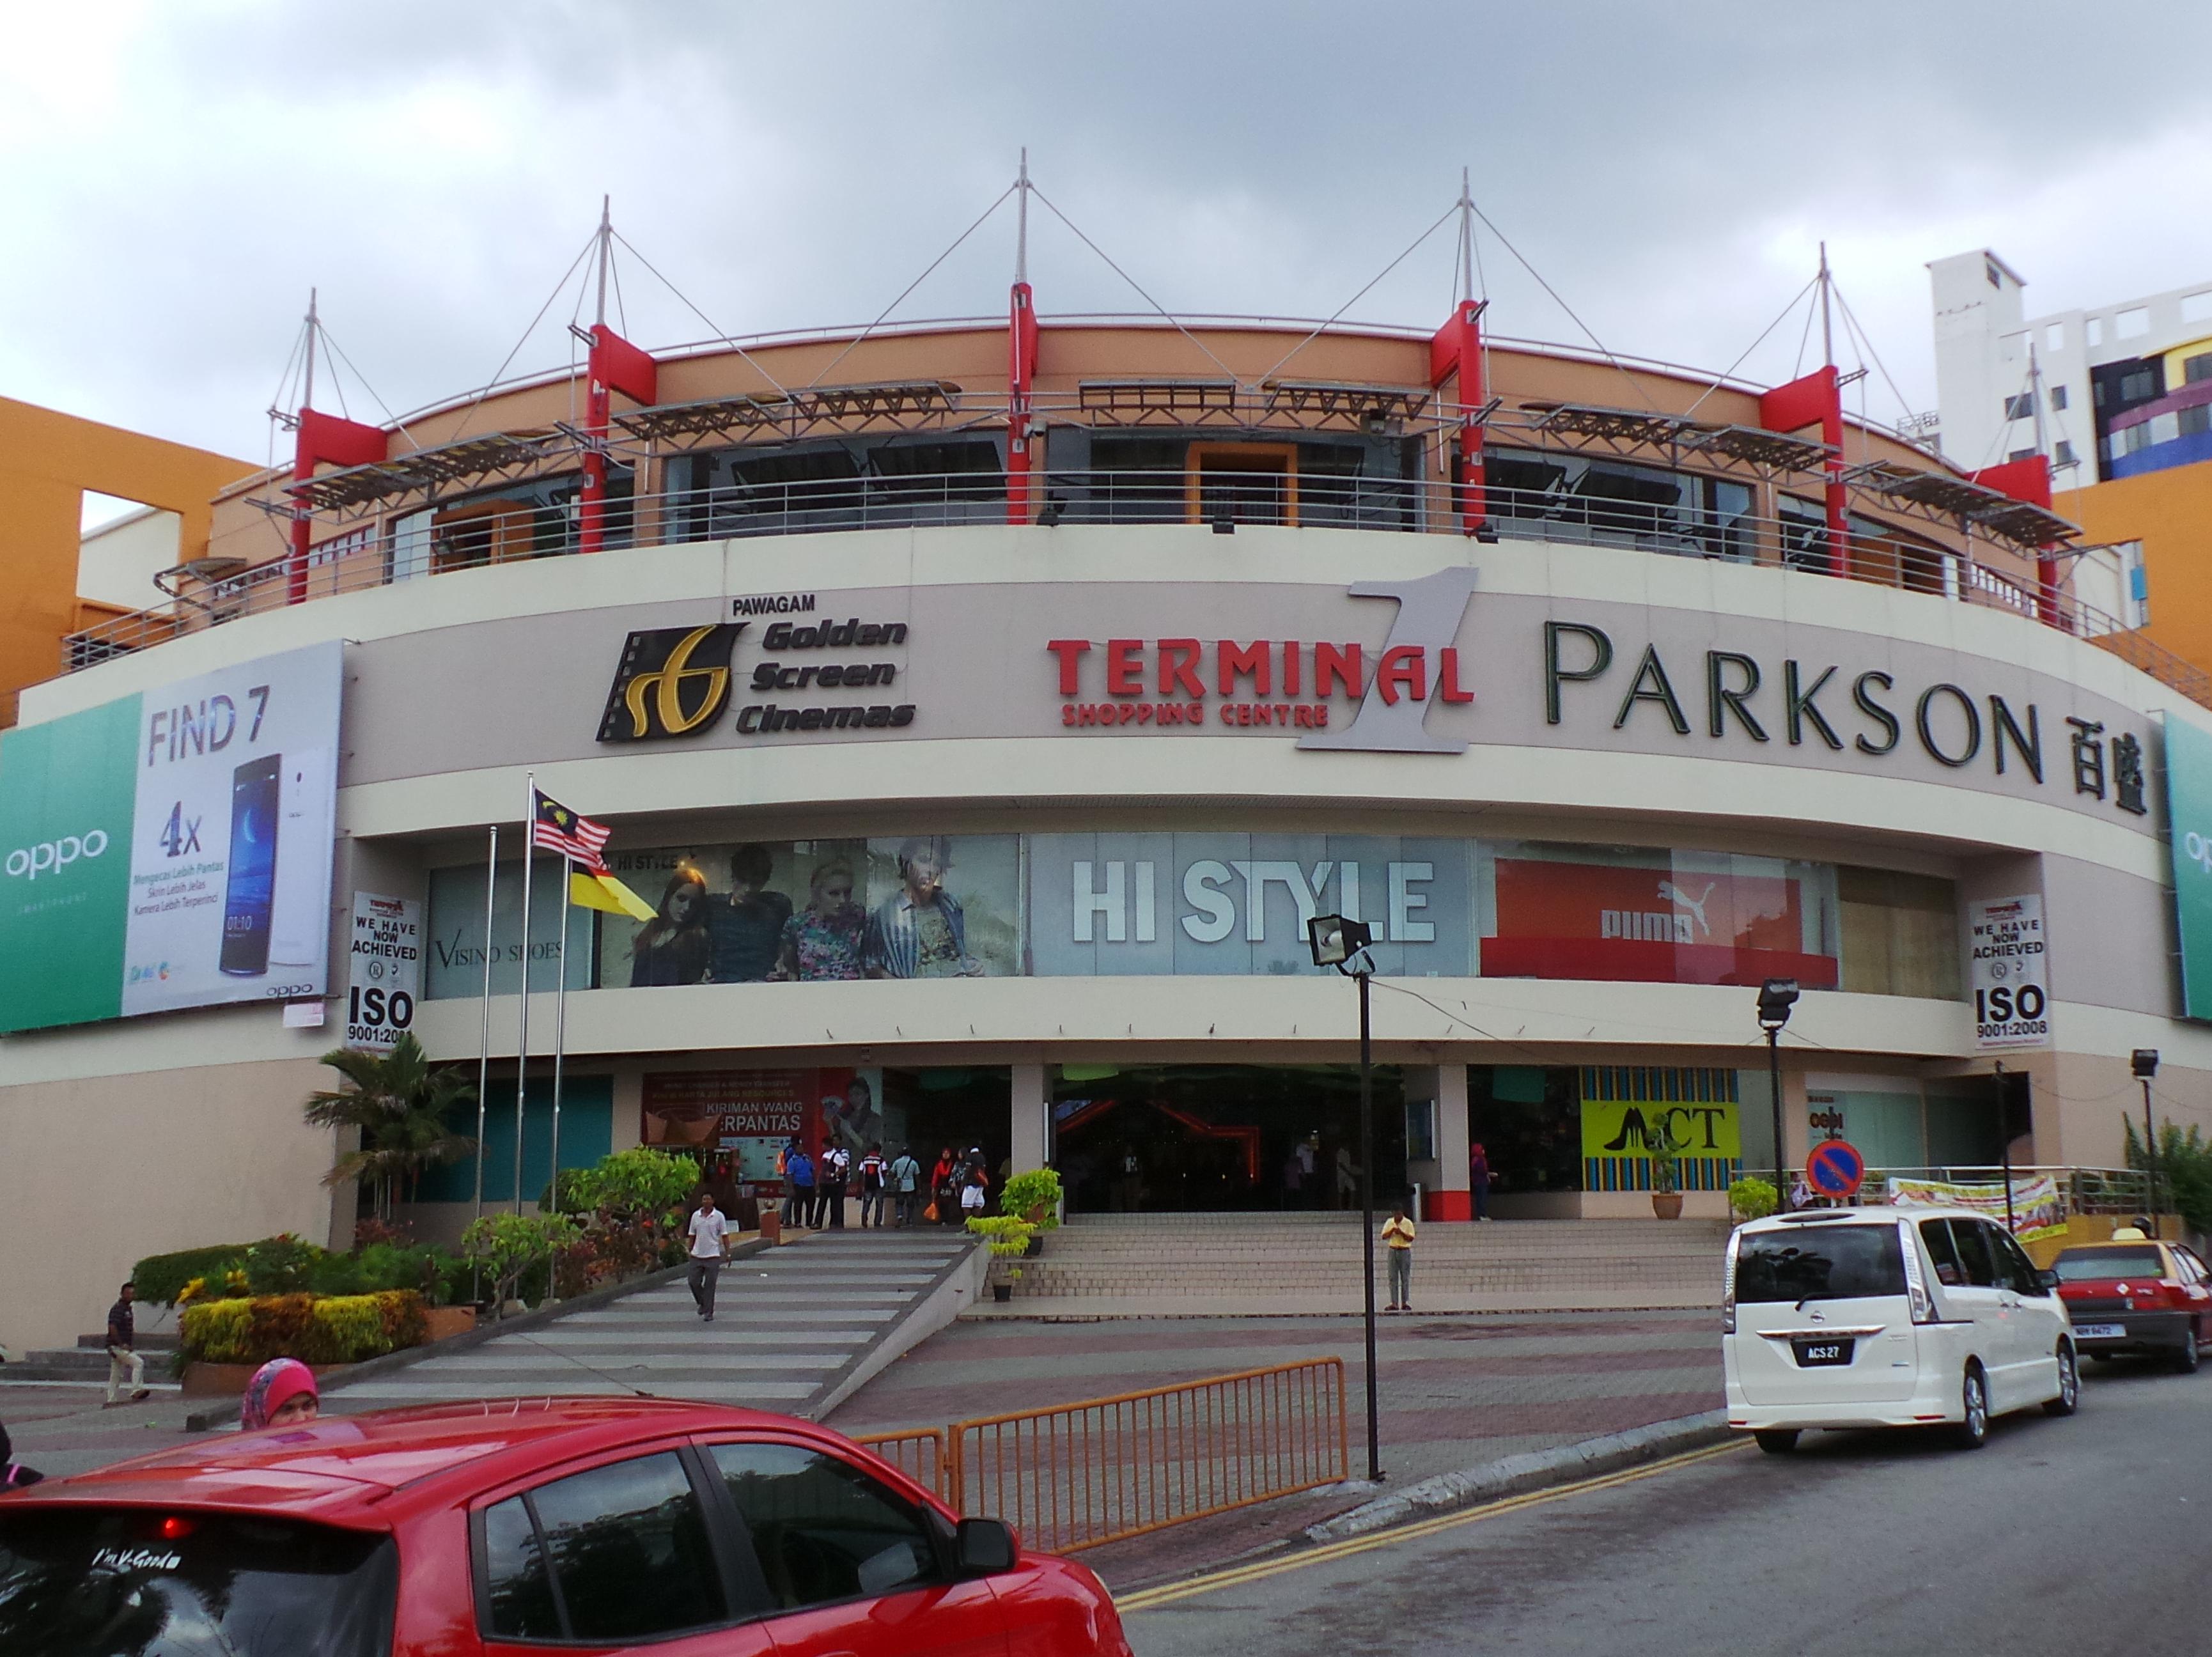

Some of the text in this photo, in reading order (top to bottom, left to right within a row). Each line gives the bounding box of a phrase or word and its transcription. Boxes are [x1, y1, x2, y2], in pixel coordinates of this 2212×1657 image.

[733, 594, 815, 616] PAWAGAM
[762, 618, 908, 650] Golden
[1047, 566, 1479, 753] TERMINAL 1
[750, 662, 896, 690] Screen
[1544, 620, 2044, 784] PARKSON
[148, 685, 270, 767] FIND 7
[736, 704, 916, 734] Cinemas
[1062, 703, 1328, 727] SHOPPING CENTRE
[6, 830, 108, 880] oppo
[173, 865, 194, 878] Lebih
[196, 862, 224, 874] Pantas
[167, 882, 187, 895] Lebih
[188, 880, 205, 891] Jelas
[134, 905, 159, 915] Kamera
[161, 899, 180, 911] Lebih
[1073, 860, 1435, 942] HI STYLE
[356, 916, 416, 935] WE HAVE
[374, 930, 398, 943] NOW
[1601, 910, 1692, 944] PUMA
[1974, 919, 2038, 936] WE HAVE
[352, 940, 417, 960] ACHIEVED
[1974, 941, 2043, 959] ACHIEVED
[349, 986, 413, 1029] ISO
[1976, 984, 2045, 1023] ISO
[348, 1025, 412, 1043] 9001:20
[1977, 1021, 2047, 1038] 9001:2008
[706, 1101, 803, 1114] KIRIMAN WANG
[1808, 1346, 1839, 1358] ACS 27
